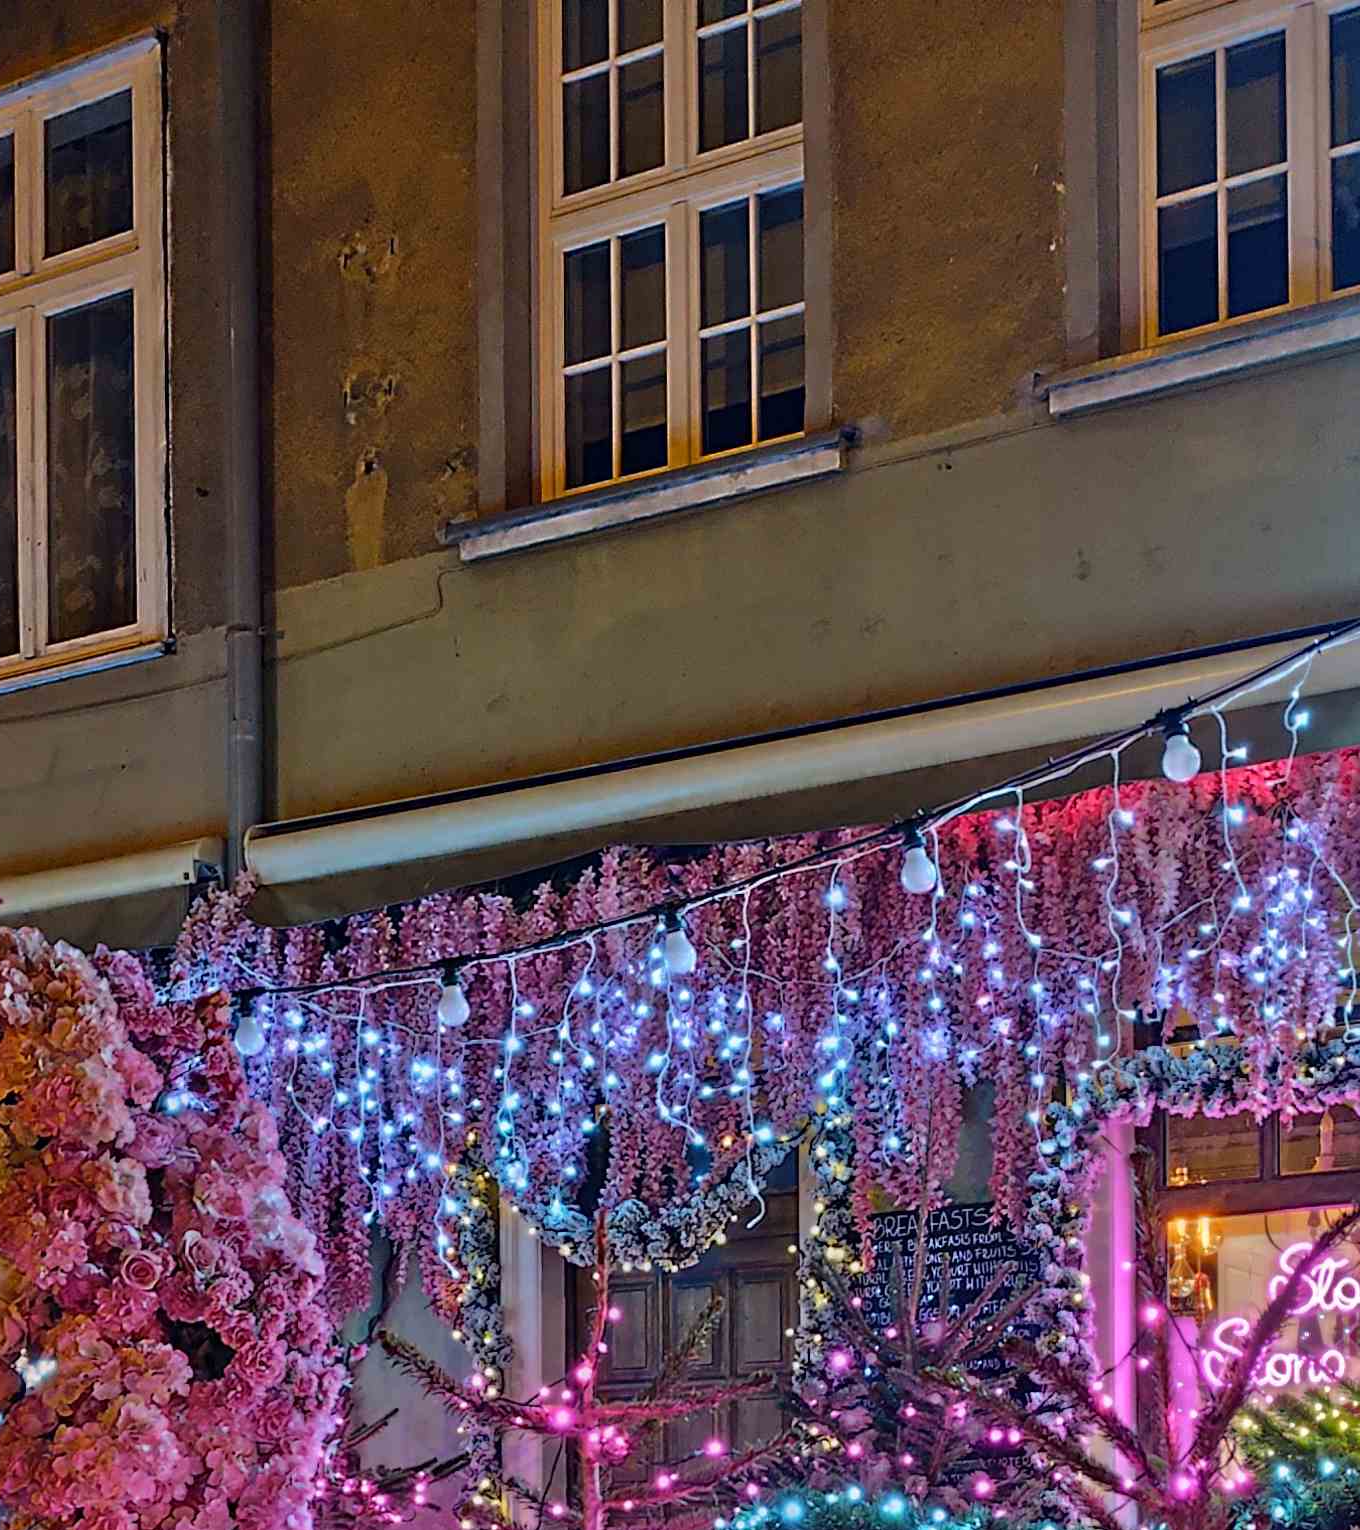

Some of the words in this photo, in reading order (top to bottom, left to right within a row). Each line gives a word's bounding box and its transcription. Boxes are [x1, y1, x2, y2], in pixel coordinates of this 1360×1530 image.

[873, 1207, 991, 1240] BREAFASTS
[974, 1245, 1017, 1260] FRUITS
[1200, 1317, 1347, 1388] Sono
